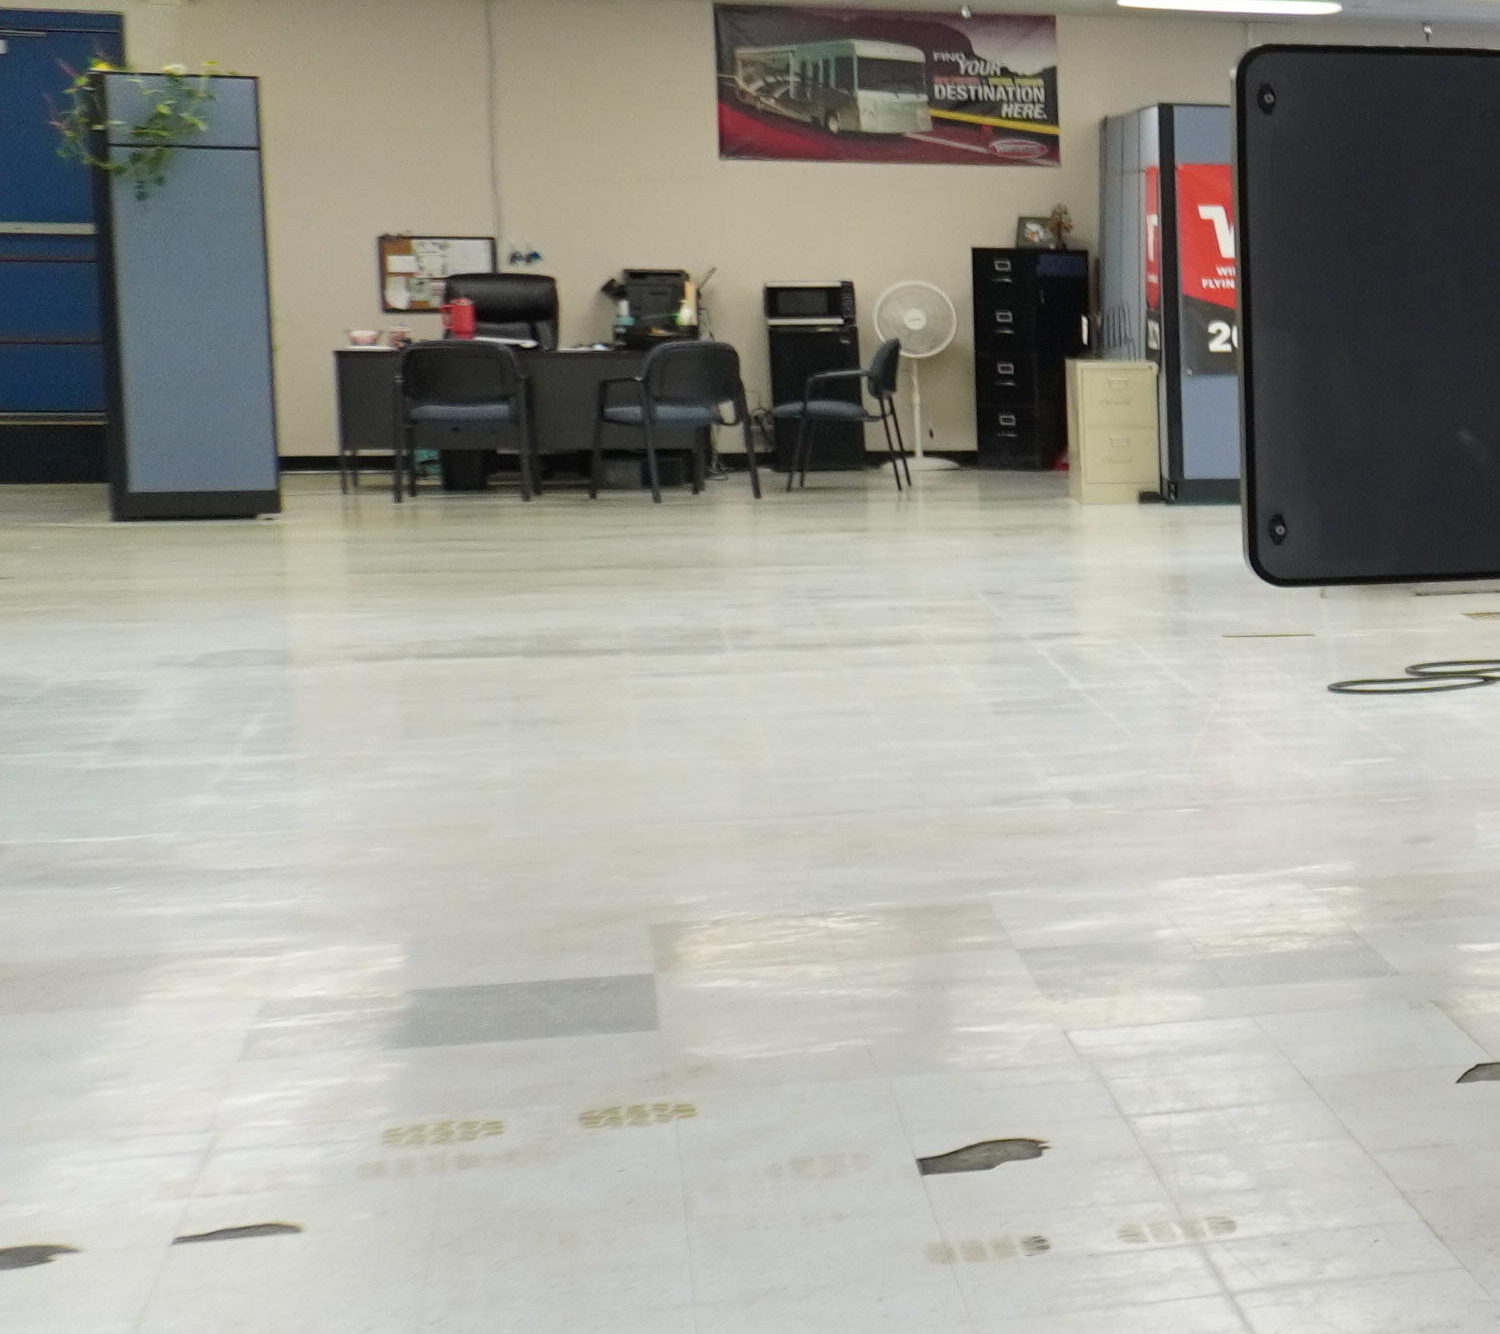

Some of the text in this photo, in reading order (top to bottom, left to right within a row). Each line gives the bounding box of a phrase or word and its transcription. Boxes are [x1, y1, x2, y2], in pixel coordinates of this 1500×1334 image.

[933, 52, 965, 63] FIND
[959, 59, 1001, 76] YOUR
[933, 84, 1045, 103] DESTINATION
[1001, 103, 1047, 119] HERE.
[1201, 278, 1236, 290] FLYIN
